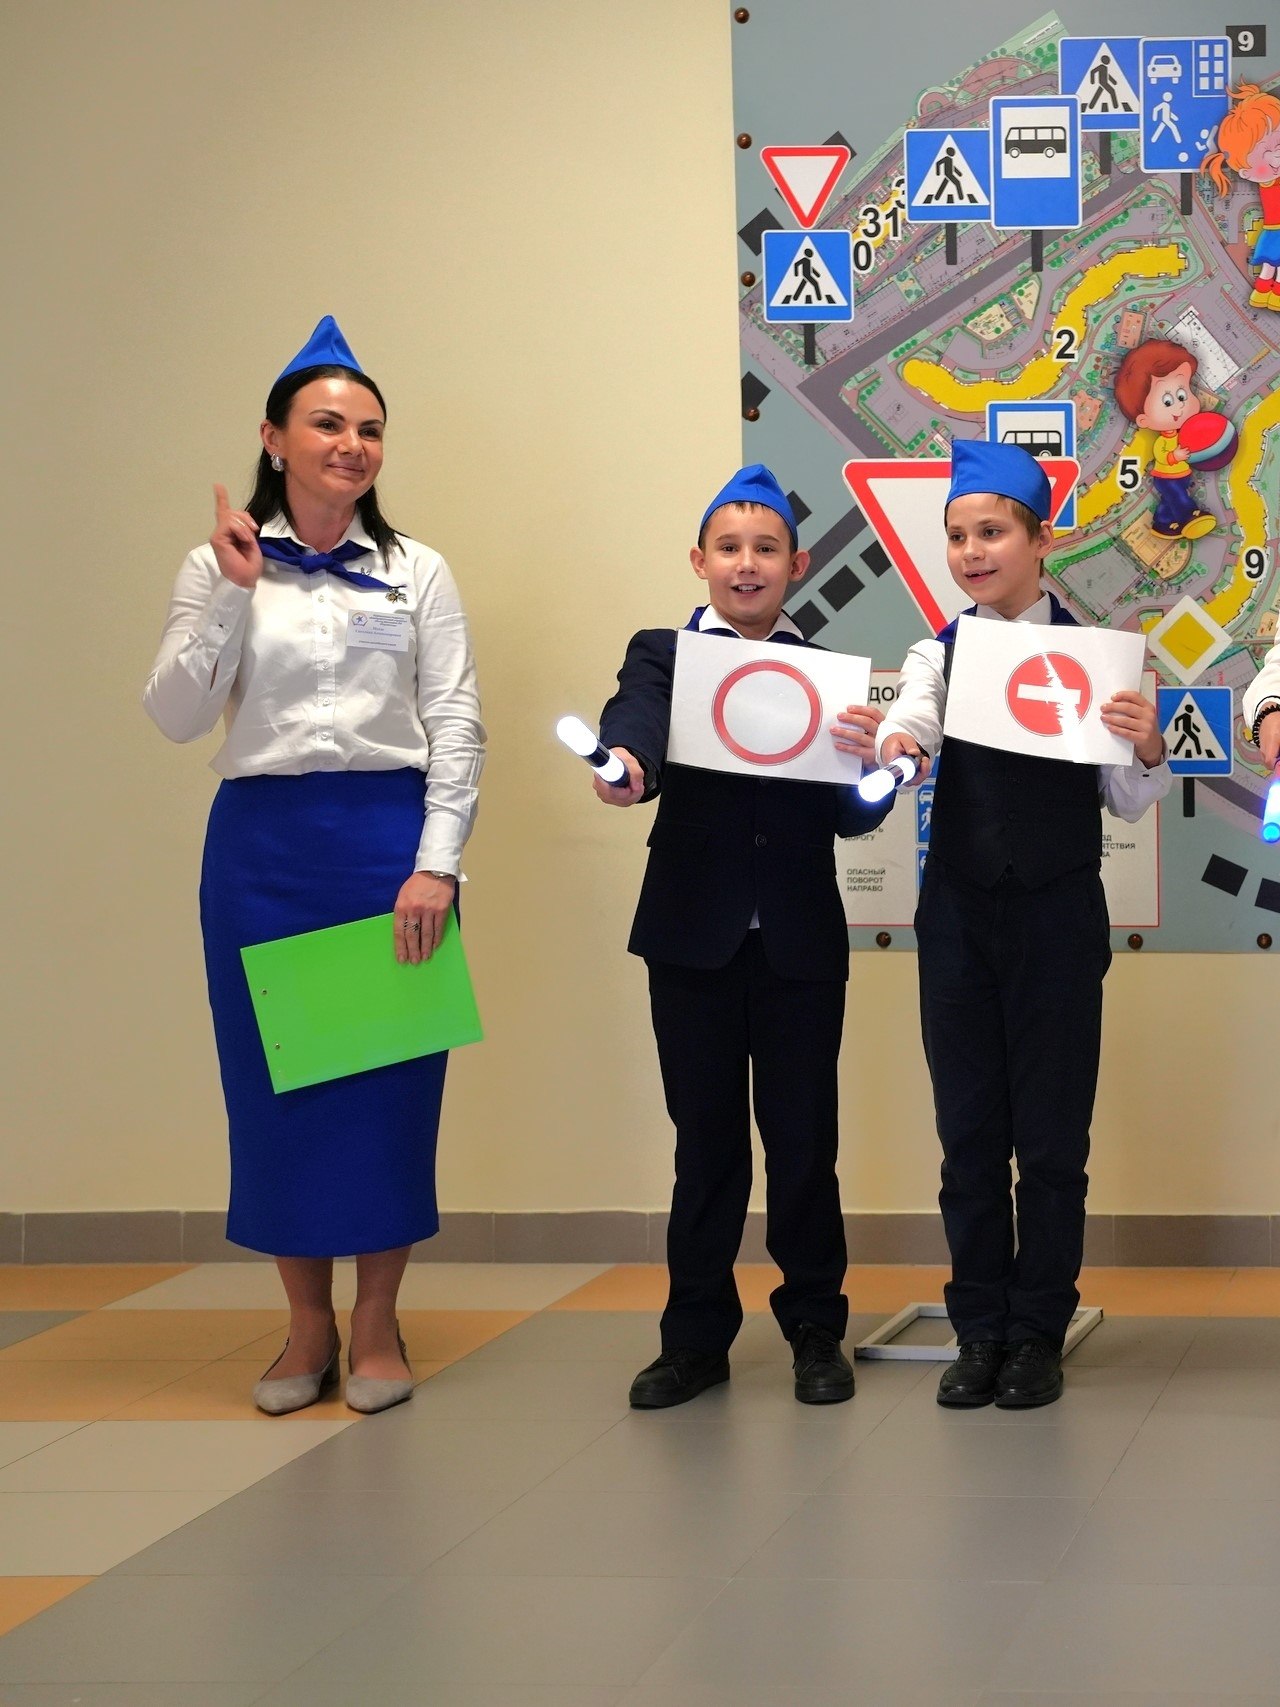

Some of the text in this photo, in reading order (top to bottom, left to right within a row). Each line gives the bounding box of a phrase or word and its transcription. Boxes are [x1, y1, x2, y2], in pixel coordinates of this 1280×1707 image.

[1237, 31, 1255, 52] 9
[862, 207, 898, 238] 31
[853, 240, 872, 271] 0
[1055, 329, 1075, 359] 2
[1119, 459, 1140, 489] 5
[1245, 549, 1265, 579] 9
[847, 867, 886, 875] ОПАСНЫЙ
